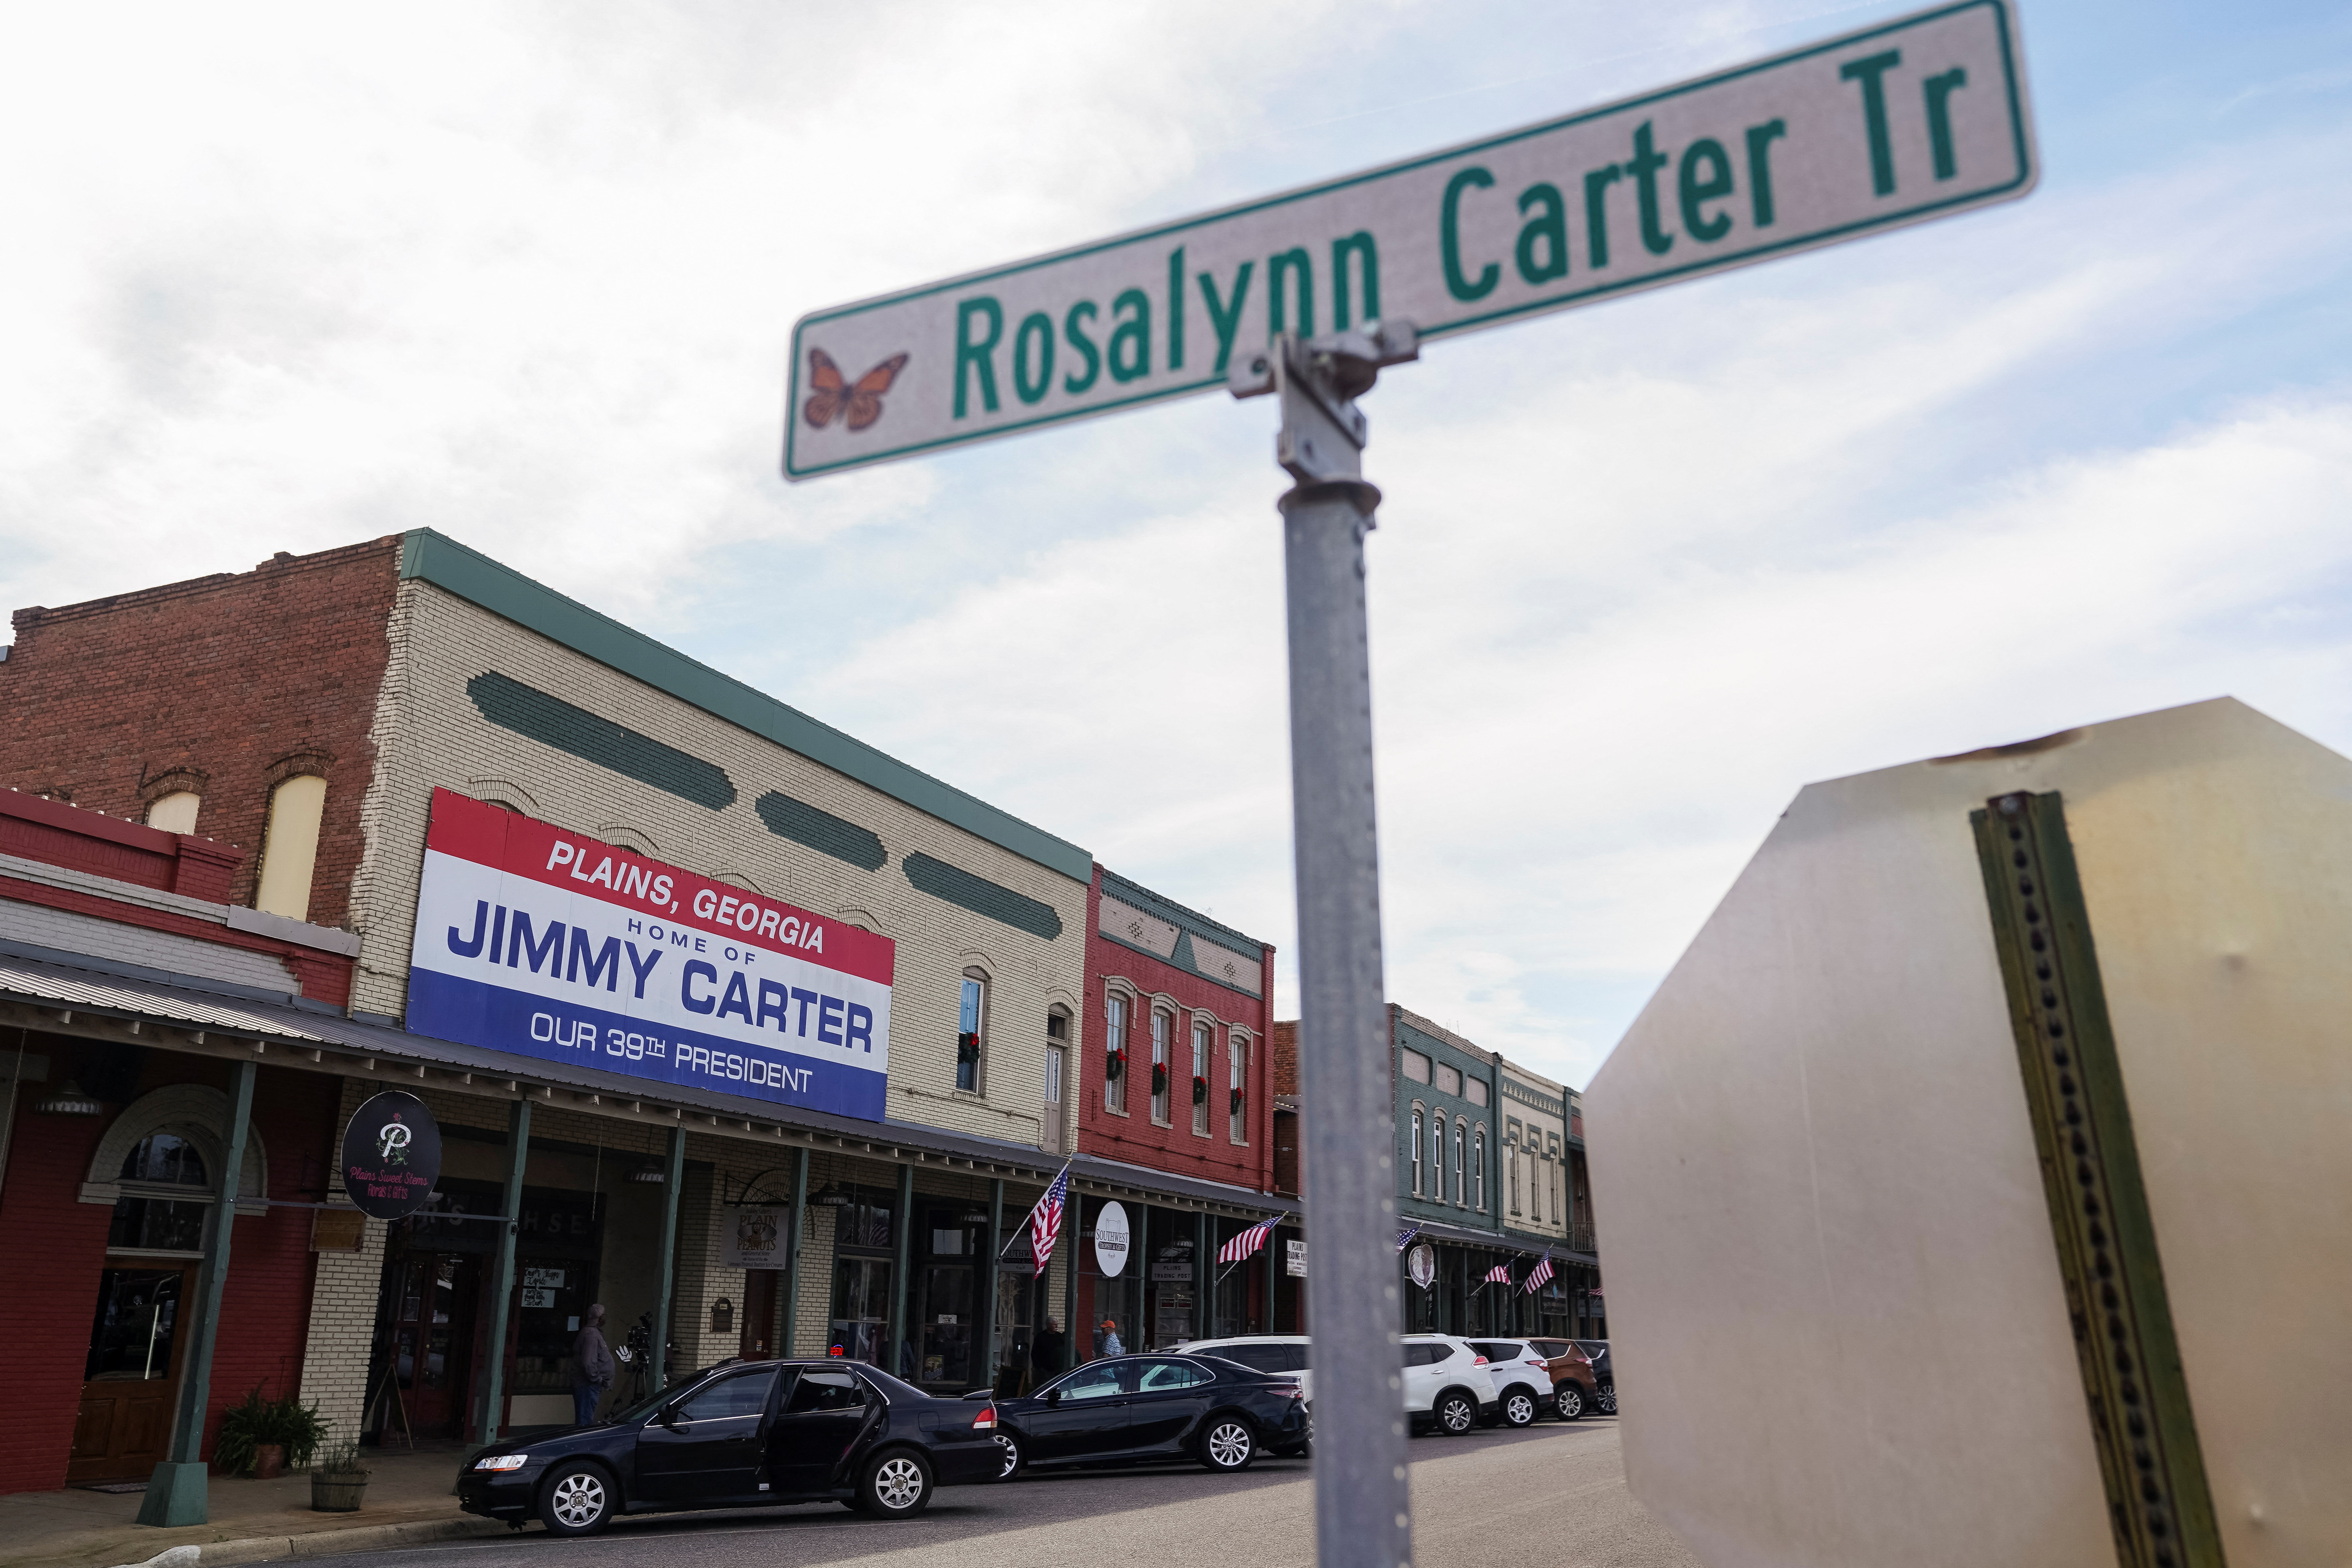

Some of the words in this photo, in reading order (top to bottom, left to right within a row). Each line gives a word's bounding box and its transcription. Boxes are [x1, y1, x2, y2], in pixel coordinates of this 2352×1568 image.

[952, 230, 1381, 420] Rosalynn
[1440, 118, 1786, 303] Carter
[1840, 48, 1967, 197] Tr
[546, 840, 678, 914] PLAINS,
[693, 889, 823, 954] GEORGIA
[628, 918, 707, 953] HOME
[724, 946, 756, 965] OF
[447, 900, 663, 999] JIMMY
[681, 959, 873, 1053] CARTER
[530, 1012, 597, 1052] OUR
[675, 1043, 813, 1093] PRESIDENT
[350, 1167, 377, 1181] Plains
[378, 1169, 402, 1183] Sweet
[405, 1172, 429, 1186] Stems
[739, 1215, 778, 1228] PLAIN
[737, 1237, 776, 1250] PEANUTS
[1096, 1229, 1128, 1243] SOUTHWEST
[1288, 1251, 1300, 1260] TRADING
[1292, 1242, 1303, 1251] PLAINS
